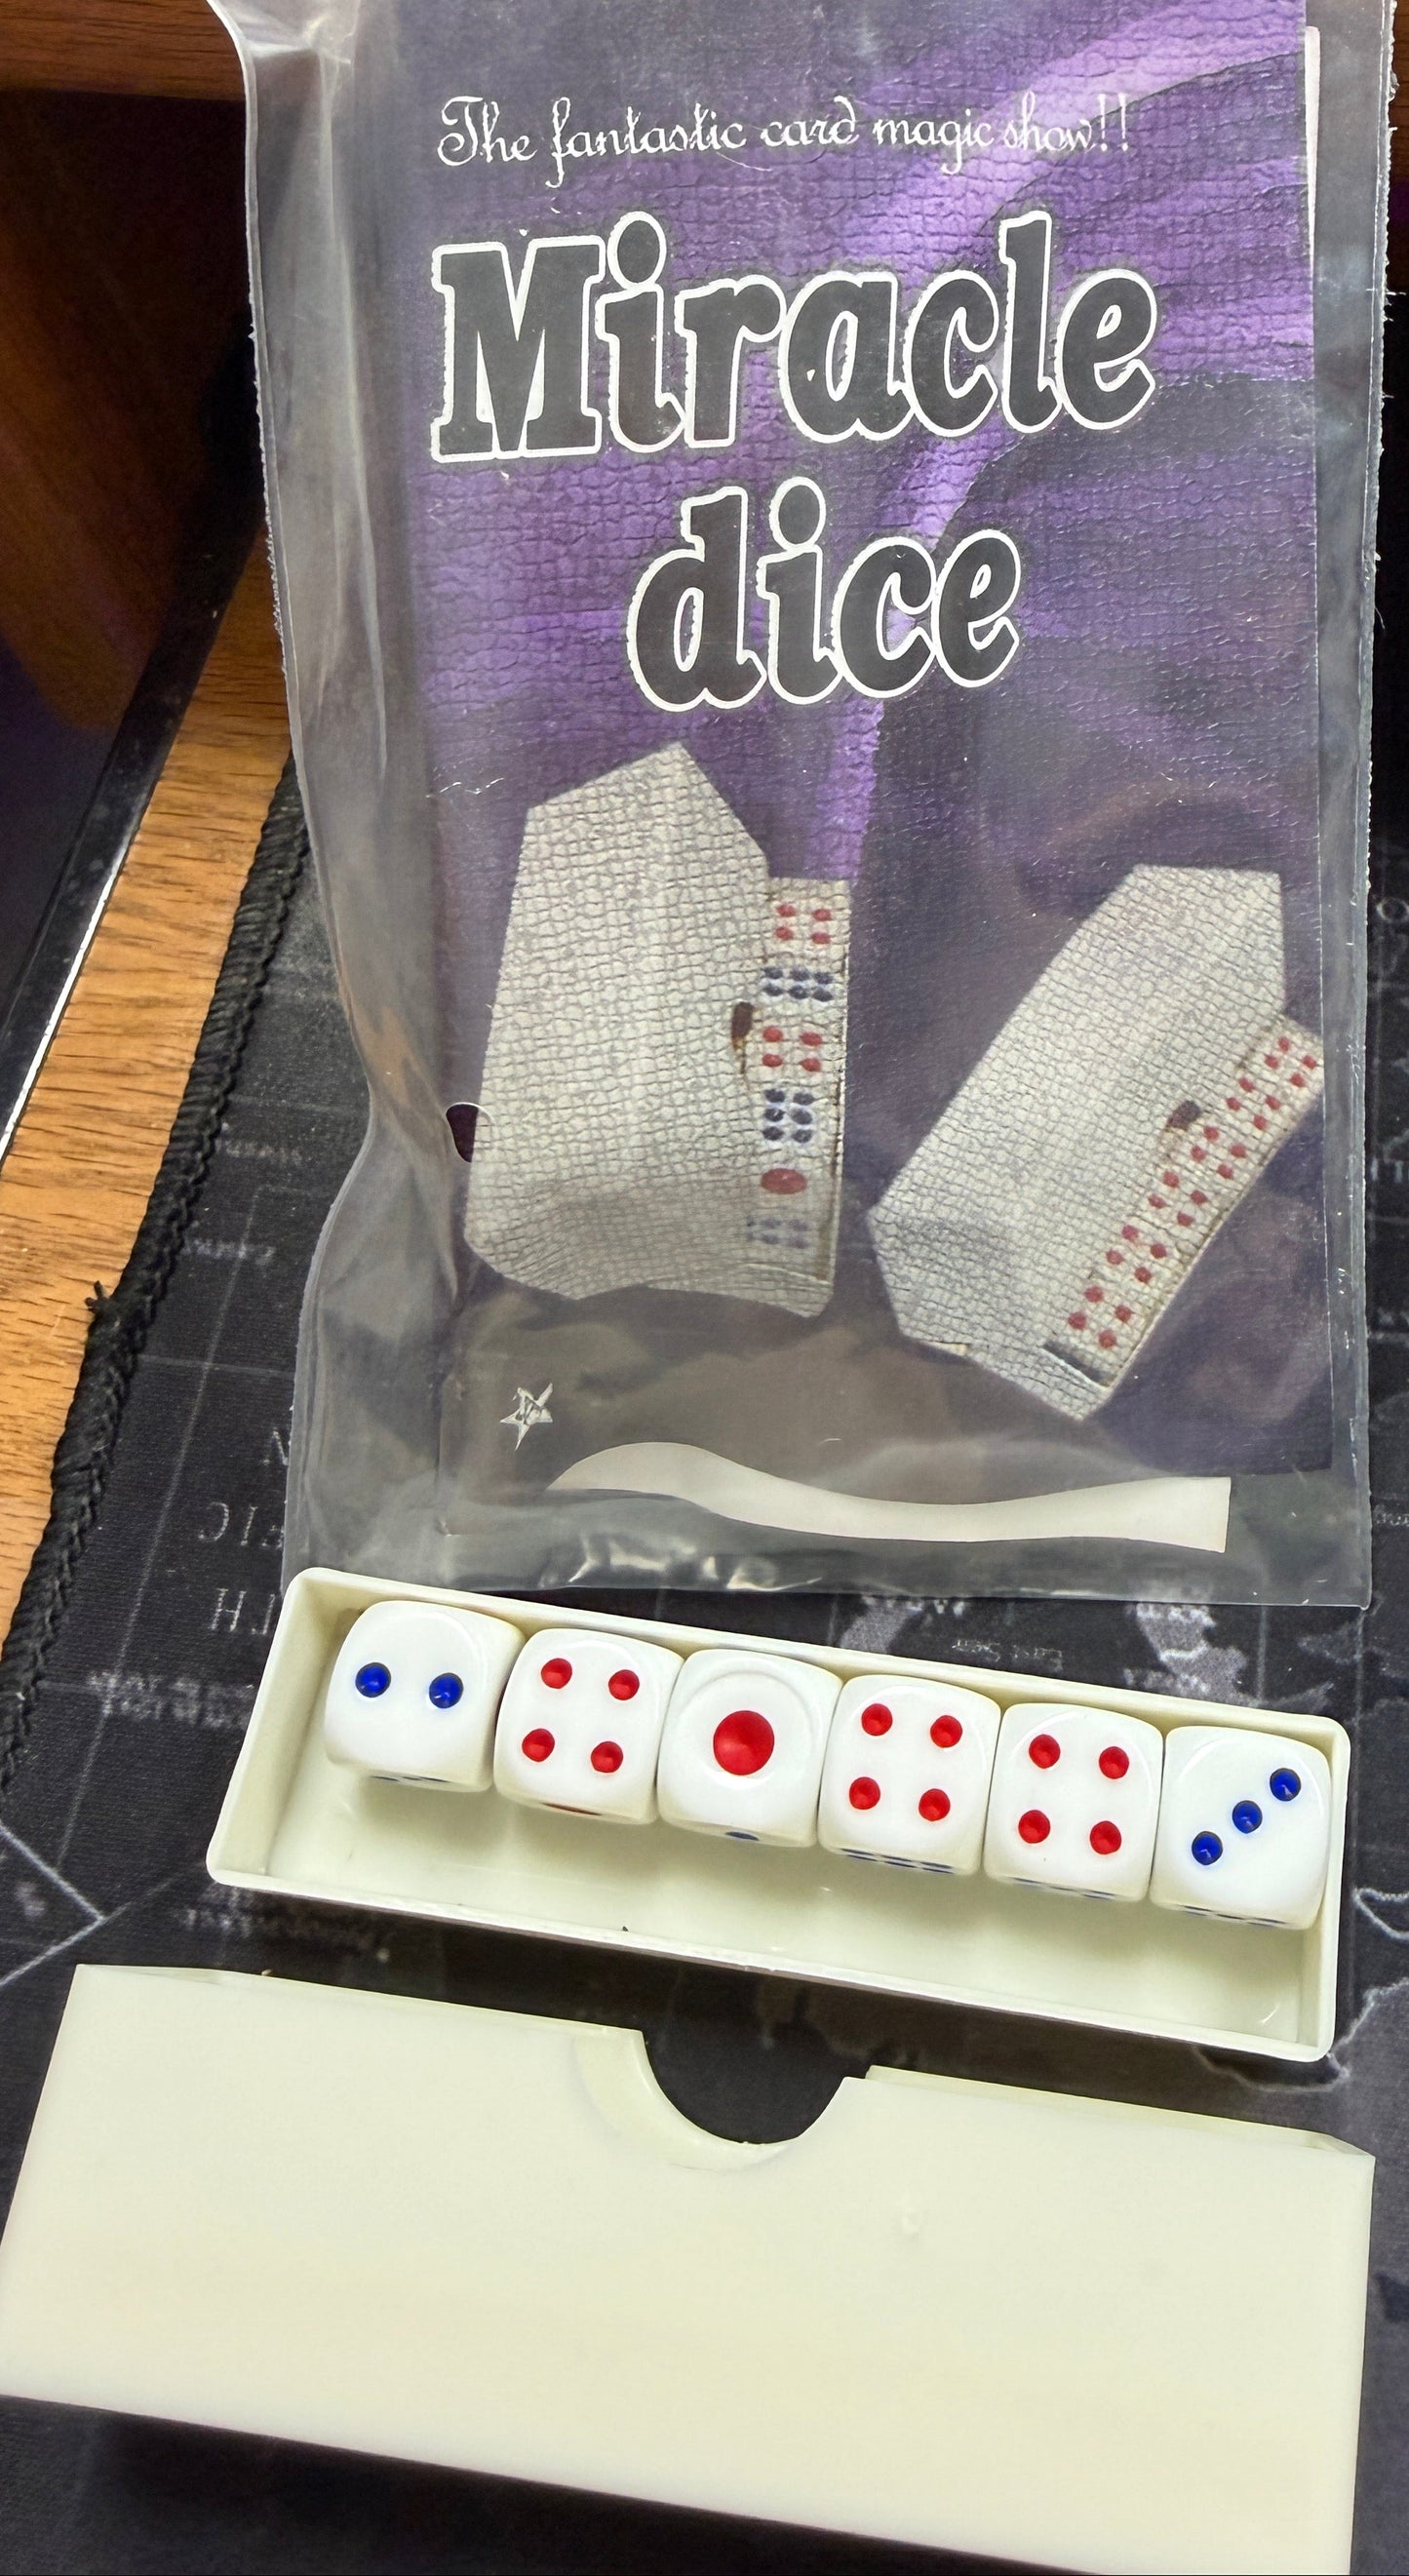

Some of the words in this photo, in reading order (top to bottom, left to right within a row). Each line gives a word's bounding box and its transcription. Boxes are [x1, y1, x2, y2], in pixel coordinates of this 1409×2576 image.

[438, 96, 536, 167] The
[546, 97, 748, 188] fantastic
[760, 96, 859, 146] card
[873, 108, 994, 174] magic
[1002, 92, 1131, 151] show!!
[430, 212, 1158, 463] Miracle
[627, 476, 1022, 712] dice
